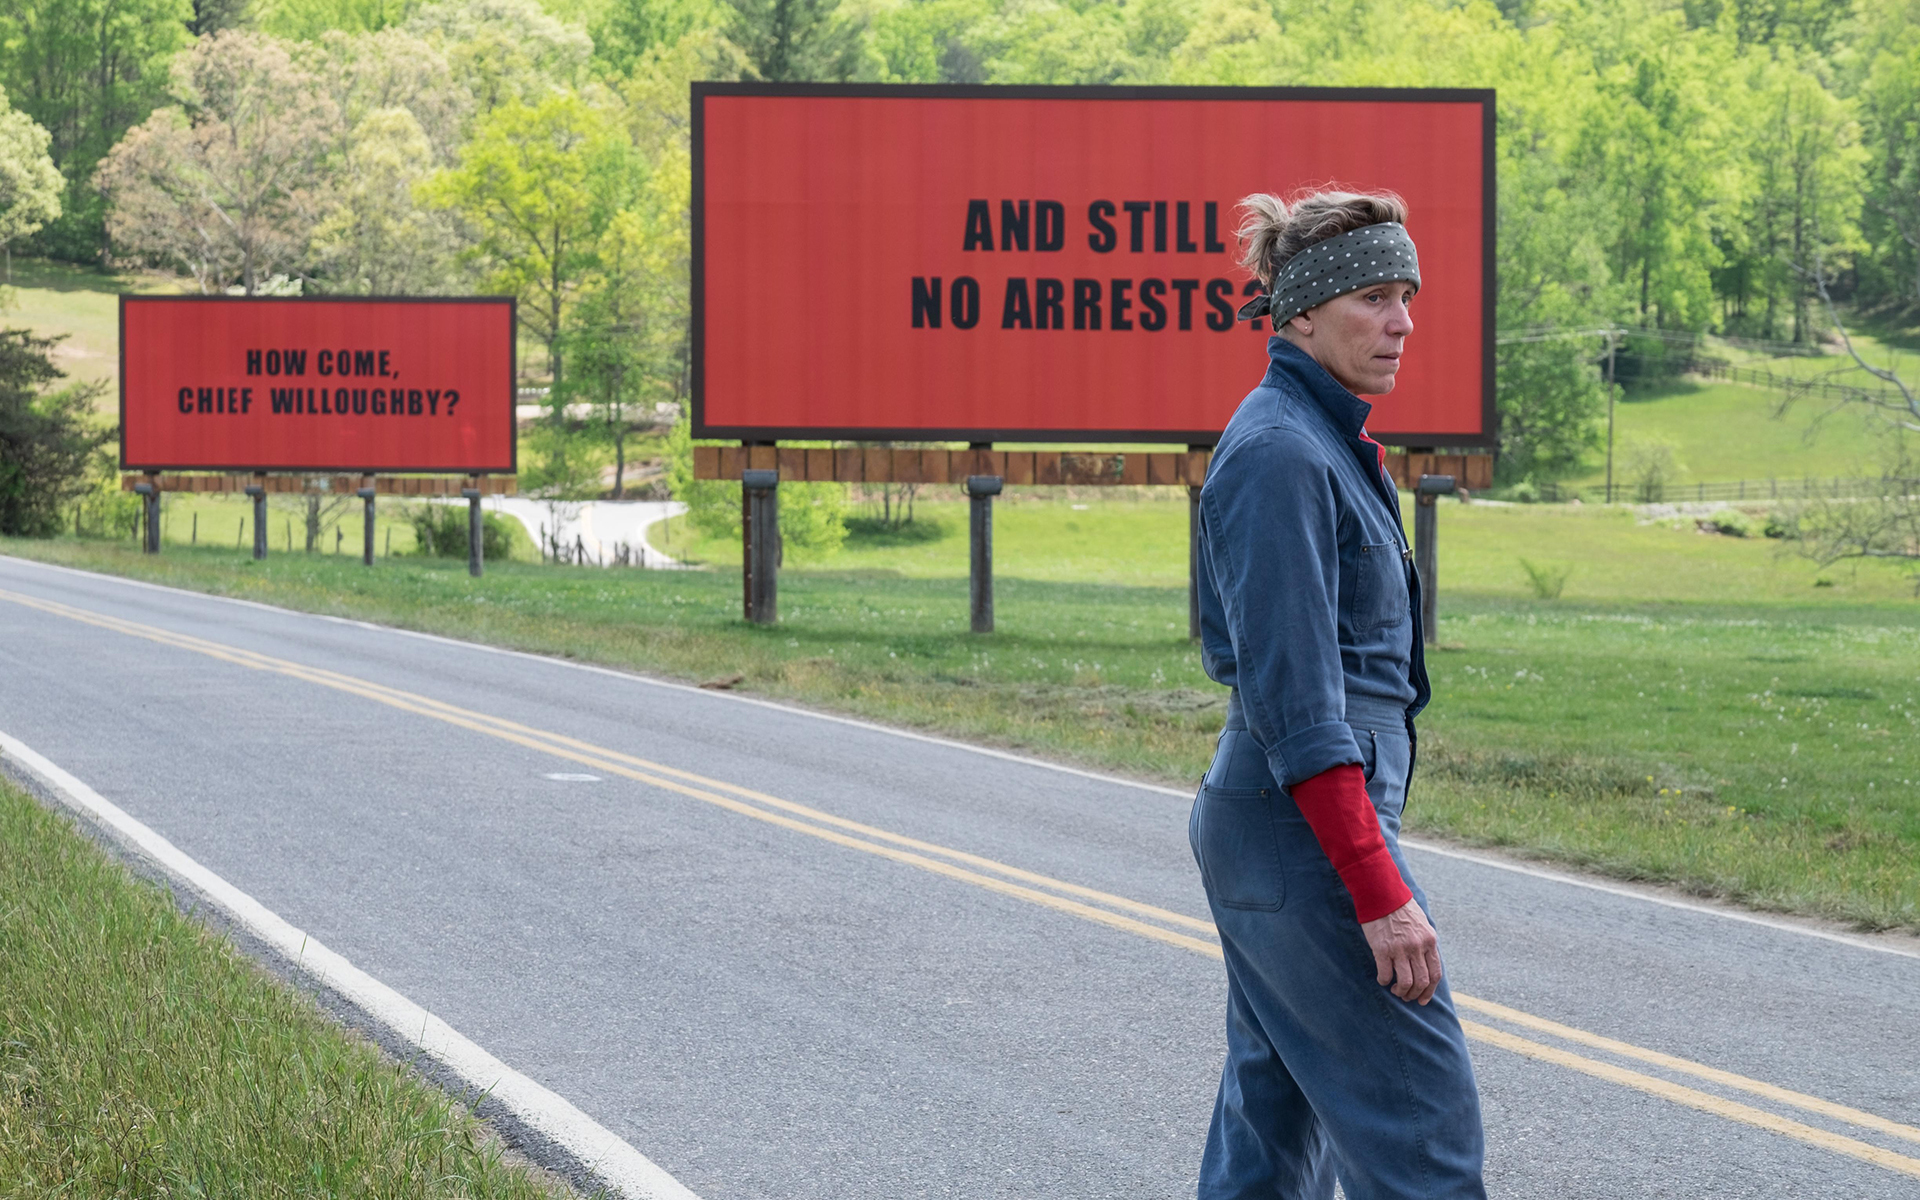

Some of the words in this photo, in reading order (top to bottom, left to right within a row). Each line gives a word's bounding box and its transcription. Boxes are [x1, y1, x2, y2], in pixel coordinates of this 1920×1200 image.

[962, 198, 1066, 252] AND
[1087, 199, 1227, 254] STILL
[911, 276, 981, 331] NO
[246, 349, 308, 376] HOW
[317, 349, 400, 381] COME,
[177, 386, 253, 415] CHIEF
[270, 387, 461, 417] WILLOUGHBY?
